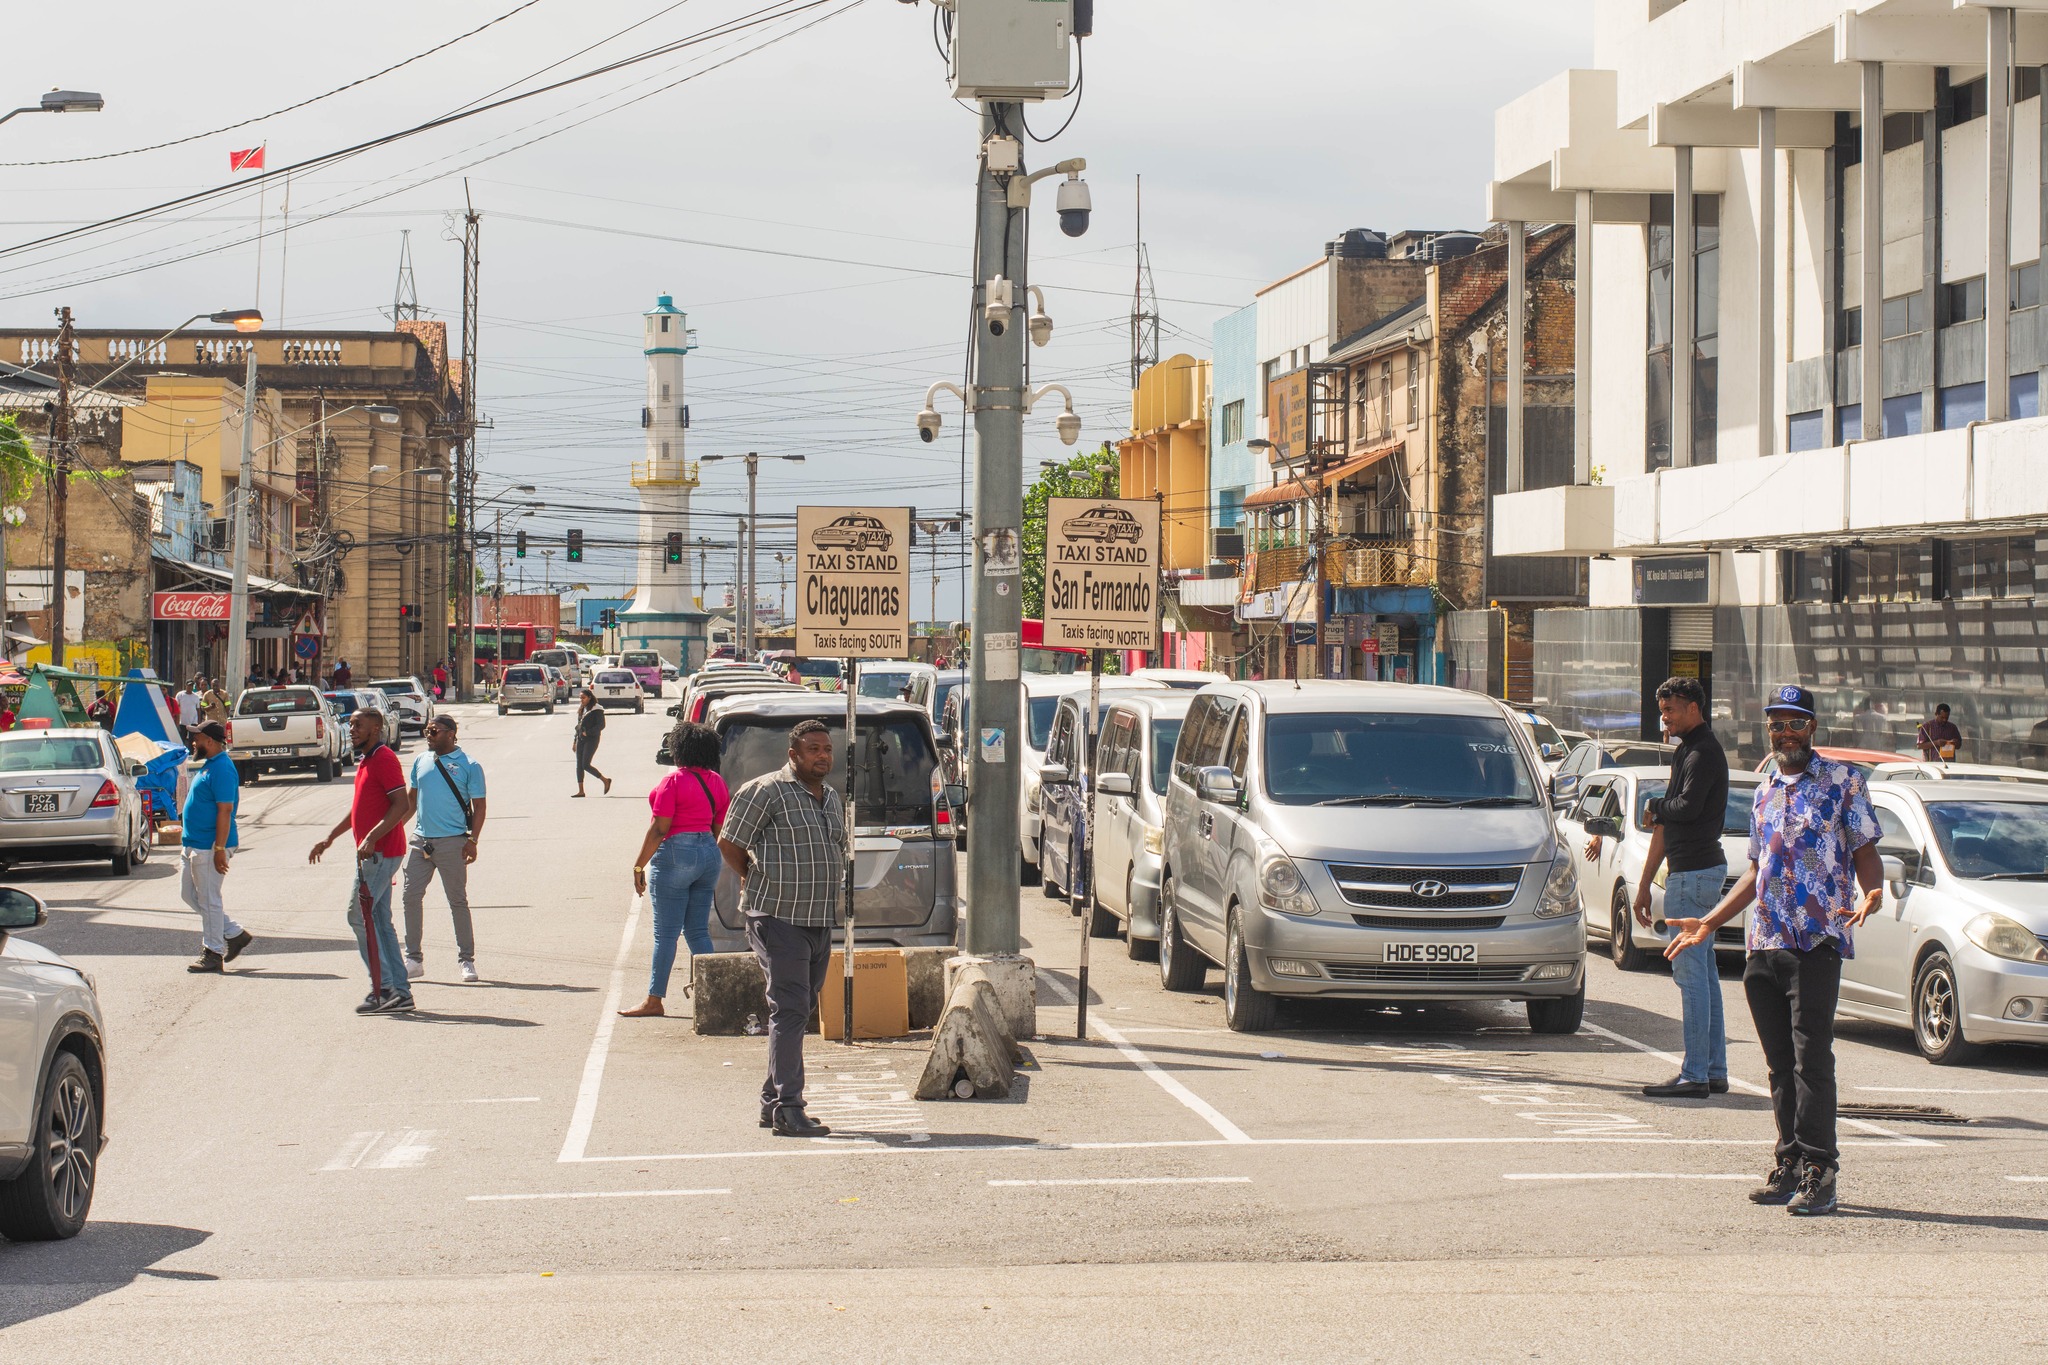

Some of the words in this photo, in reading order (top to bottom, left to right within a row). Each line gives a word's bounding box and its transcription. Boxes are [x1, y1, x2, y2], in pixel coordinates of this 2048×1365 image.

[866, 531, 885, 541] TAXI
[1116, 523, 1135, 533] TAXI
[807, 554, 841, 570] TAXI
[845, 555, 898, 570] STAND
[1057, 545, 1090, 561] TAXI
[1095, 546, 1147, 563] STAND
[1051, 568, 1078, 609] San
[1083, 570, 1150, 612] Fernando
[160, 594, 229, 617] Coca-Cola
[807, 574, 899, 626] Chaguanas
[814, 633, 837, 649] Taxis
[839, 633, 866, 652] facing
[869, 634, 902, 649] SOUTH
[1062, 624, 1084, 639] Taxis
[1087, 624, 1114, 643] facing
[1117, 631, 1150, 646] NORTH
[985, 640, 1018, 650] GOLD
[29, 803, 56, 812] 7248
[31, 794, 52, 804] PCZ
